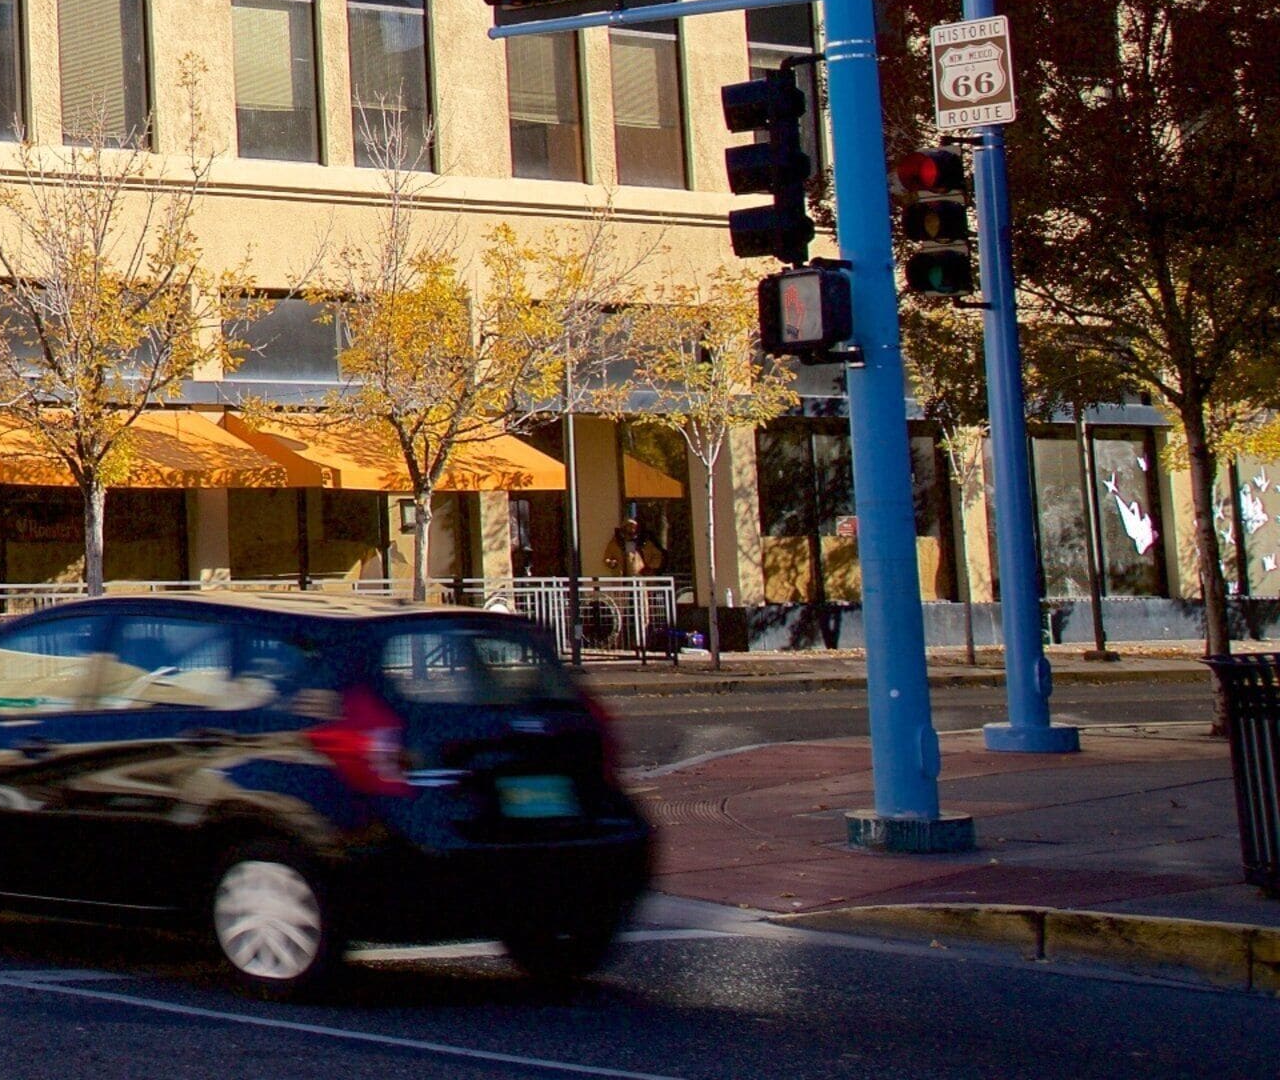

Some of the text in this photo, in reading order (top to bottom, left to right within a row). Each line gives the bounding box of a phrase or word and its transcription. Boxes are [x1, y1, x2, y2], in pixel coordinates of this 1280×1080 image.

[938, 22, 1001, 43] HISTORIC
[949, 49, 993, 63] NEW MEXICO
[952, 71, 995, 97] 66
[948, 105, 1002, 124] ROUTE
